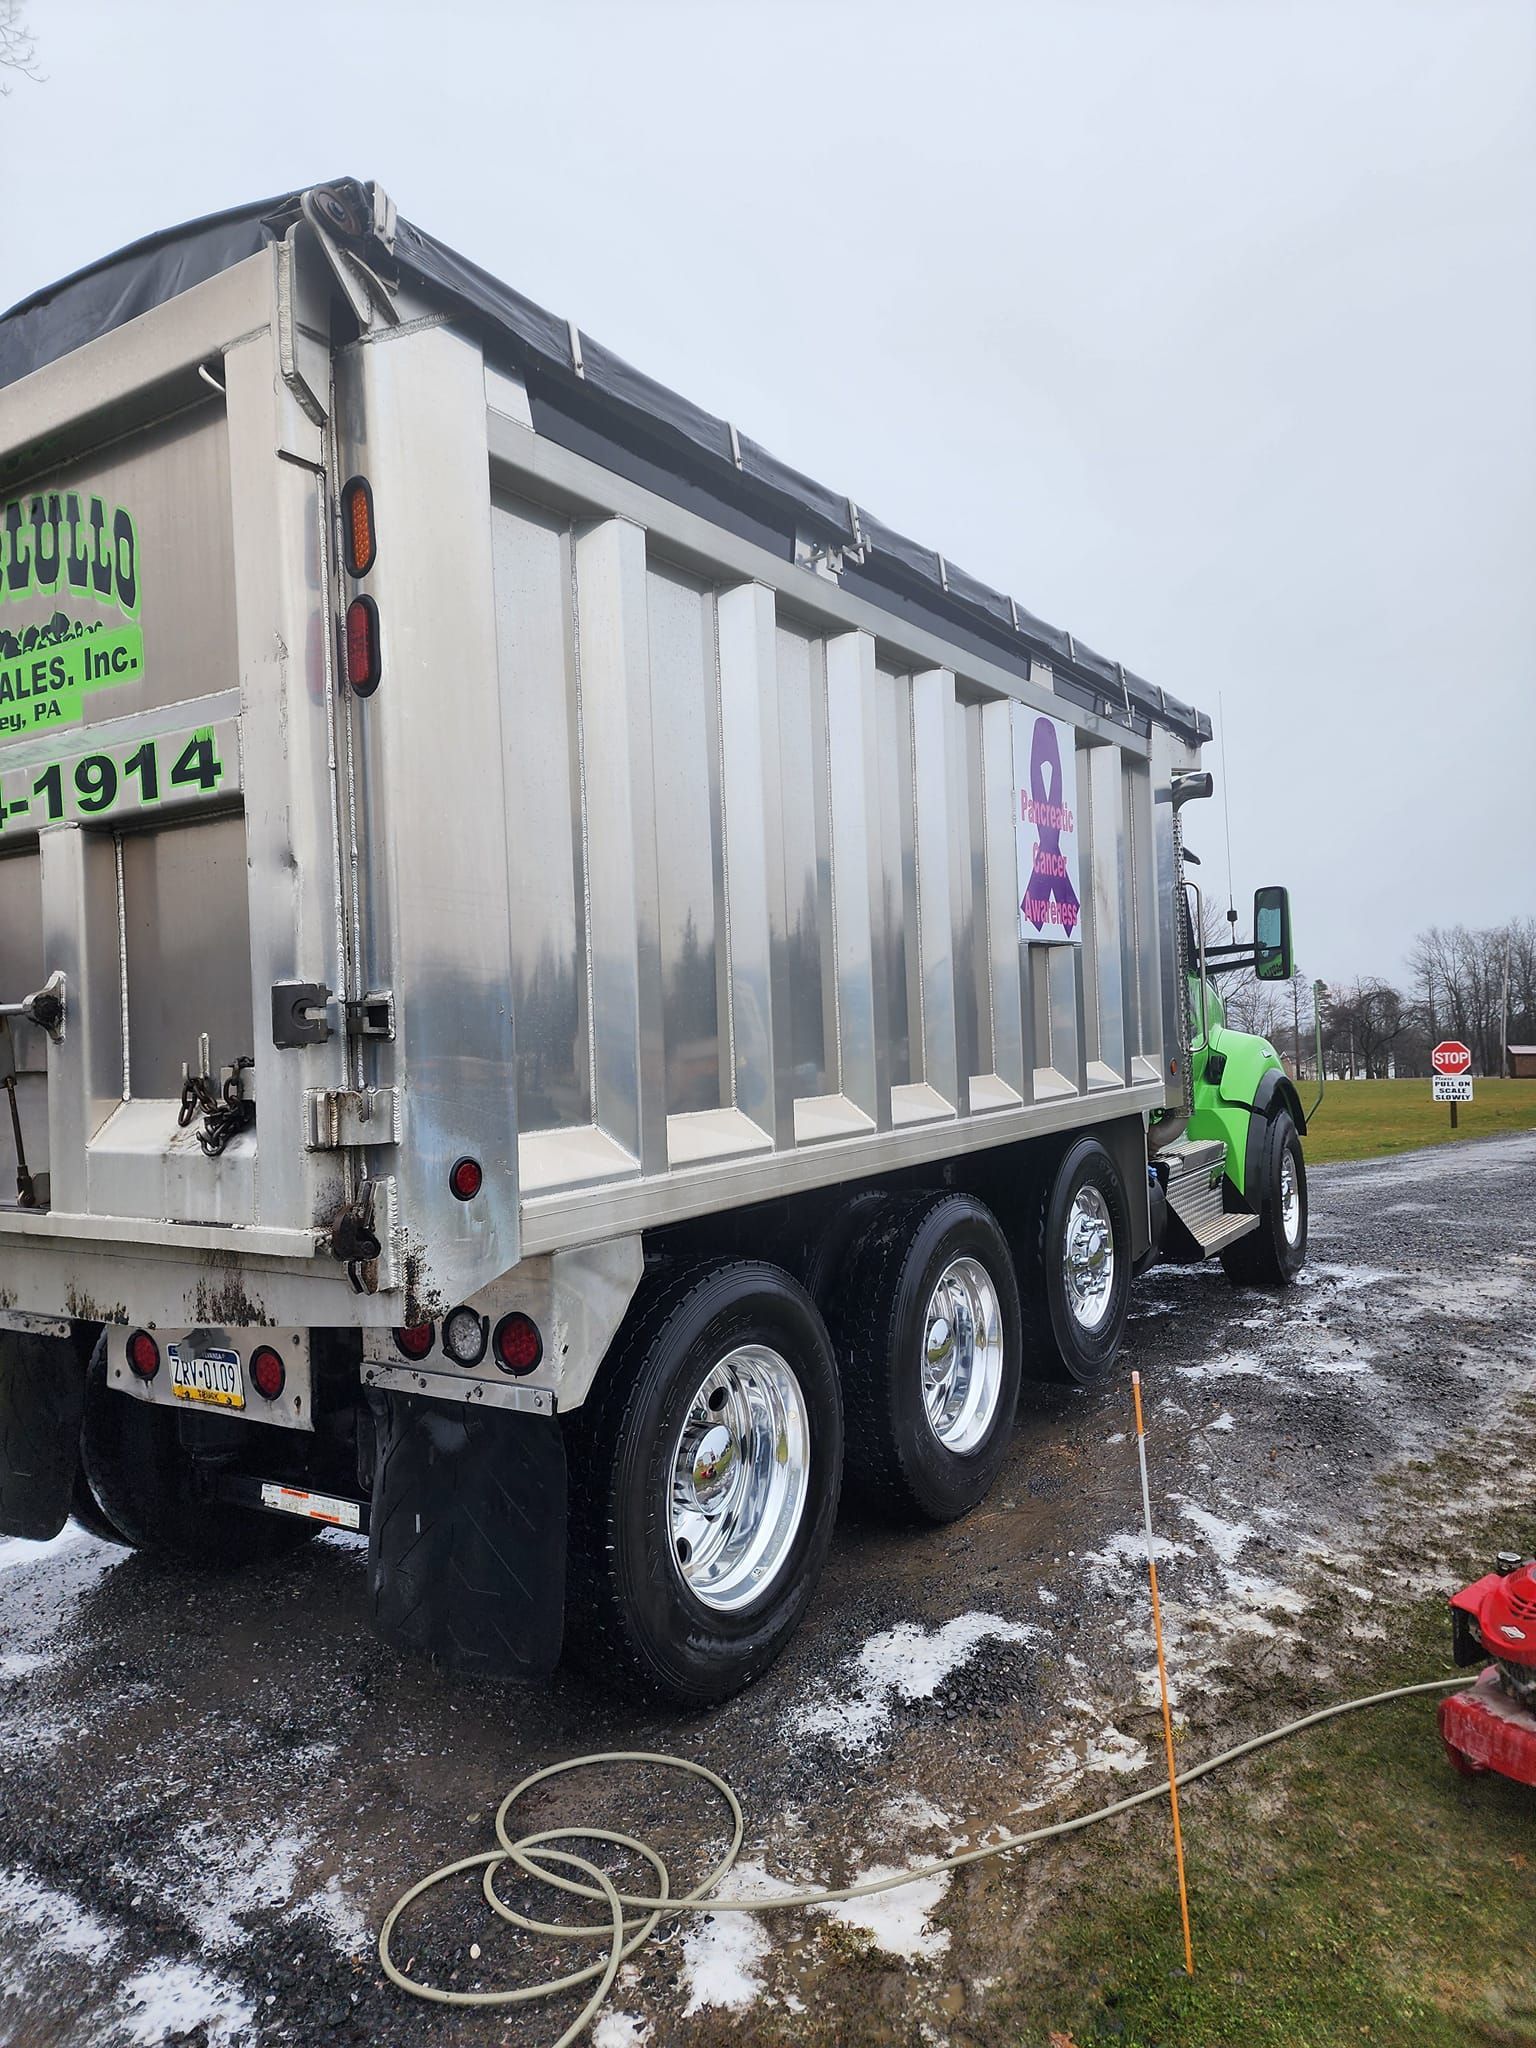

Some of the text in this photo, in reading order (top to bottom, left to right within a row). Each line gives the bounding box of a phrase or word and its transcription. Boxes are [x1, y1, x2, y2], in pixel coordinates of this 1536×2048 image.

[0, 494, 136, 609] LULLO
[85, 646, 138, 681] Inc.
[34, 699, 62, 722] PA
[0, 738, 222, 829] -1914
[1020, 789, 1074, 833] Pancreatic
[1033, 842, 1067, 878] Cancer
[1024, 891, 1078, 927] Awareness
[1435, 1052, 1468, 1064] STOP
